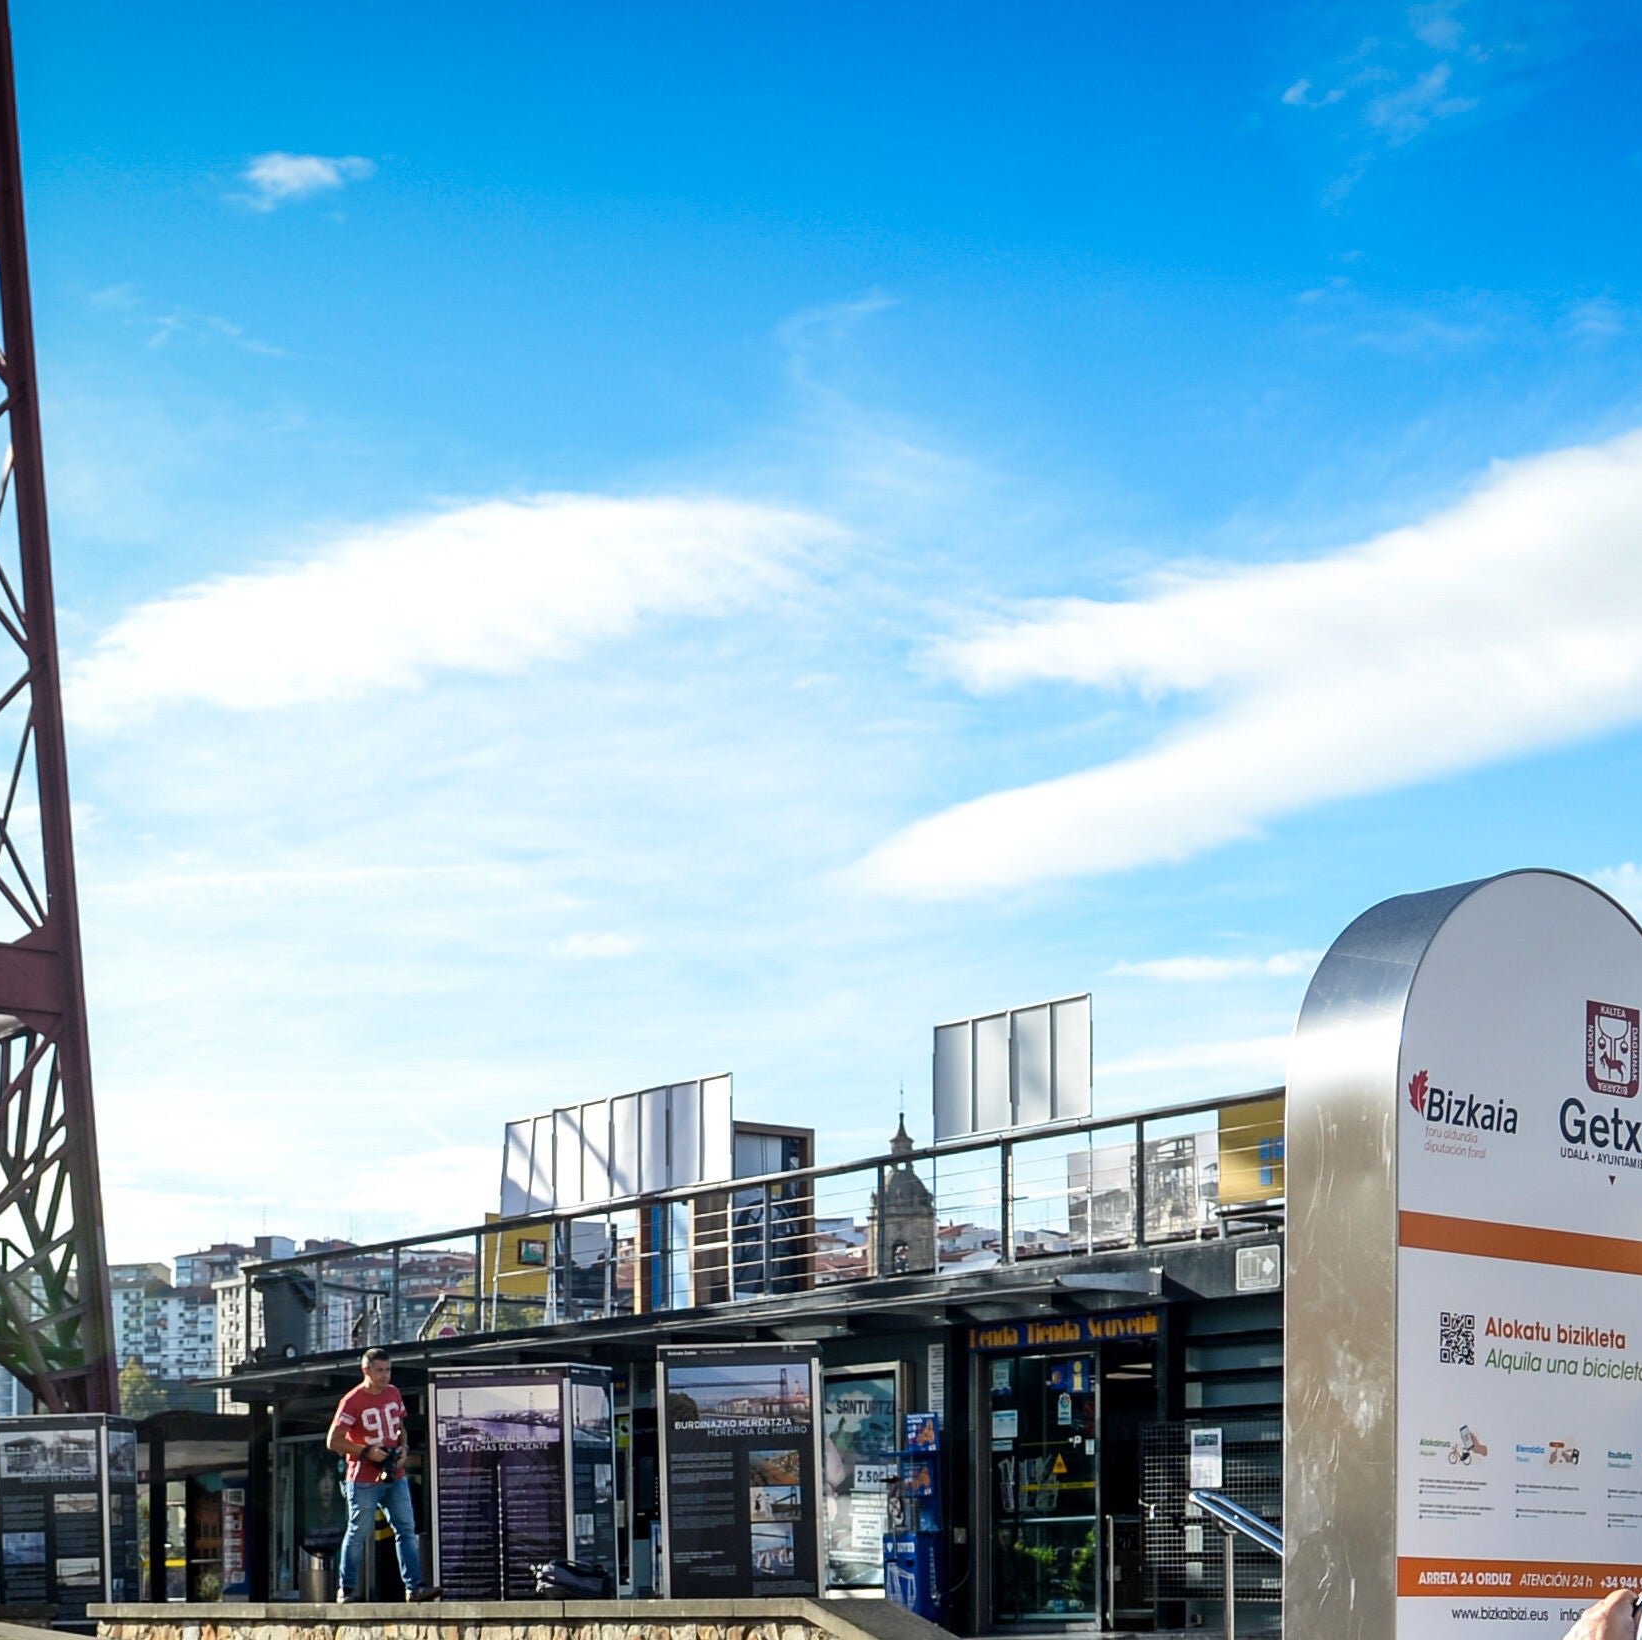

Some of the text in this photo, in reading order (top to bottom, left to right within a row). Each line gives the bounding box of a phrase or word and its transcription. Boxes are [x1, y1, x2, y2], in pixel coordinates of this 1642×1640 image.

[1600, 1005, 1627, 1019] KALTEA
[1426, 1086, 1518, 1135] Bizkaia
[1425, 1126, 1478, 1143] foru aldundia
[1424, 1141, 1487, 1159] diputación foral
[1560, 1147, 1590, 1162] UDALA
[1027, 1320, 1081, 1344] Tienda
[1485, 1316, 1626, 1349] Alokatu bizikleta
[1485, 1348, 1542, 1375] Alquila
[1547, 1358, 1578, 1376] una
[675, 1418, 792, 1430] BURDINAZKO HERENTZIA
[708, 1425, 807, 1437] HERENCIA DE HIERRO
[1418, 1571, 1457, 1585] ARRETA
[1460, 1571, 1474, 1585] 24
[1476, 1572, 1512, 1586] ORDUZ
[1519, 1571, 1571, 1588] ATENCIÓN
[1572, 1574, 1585, 1588] 24
[1586, 1574, 1593, 1588] h
[1600, 1575, 1618, 1589] +34
[1620, 1575, 1638, 1589] 944
[1451, 1606, 1549, 1622] www.bizkaibizi.eus
